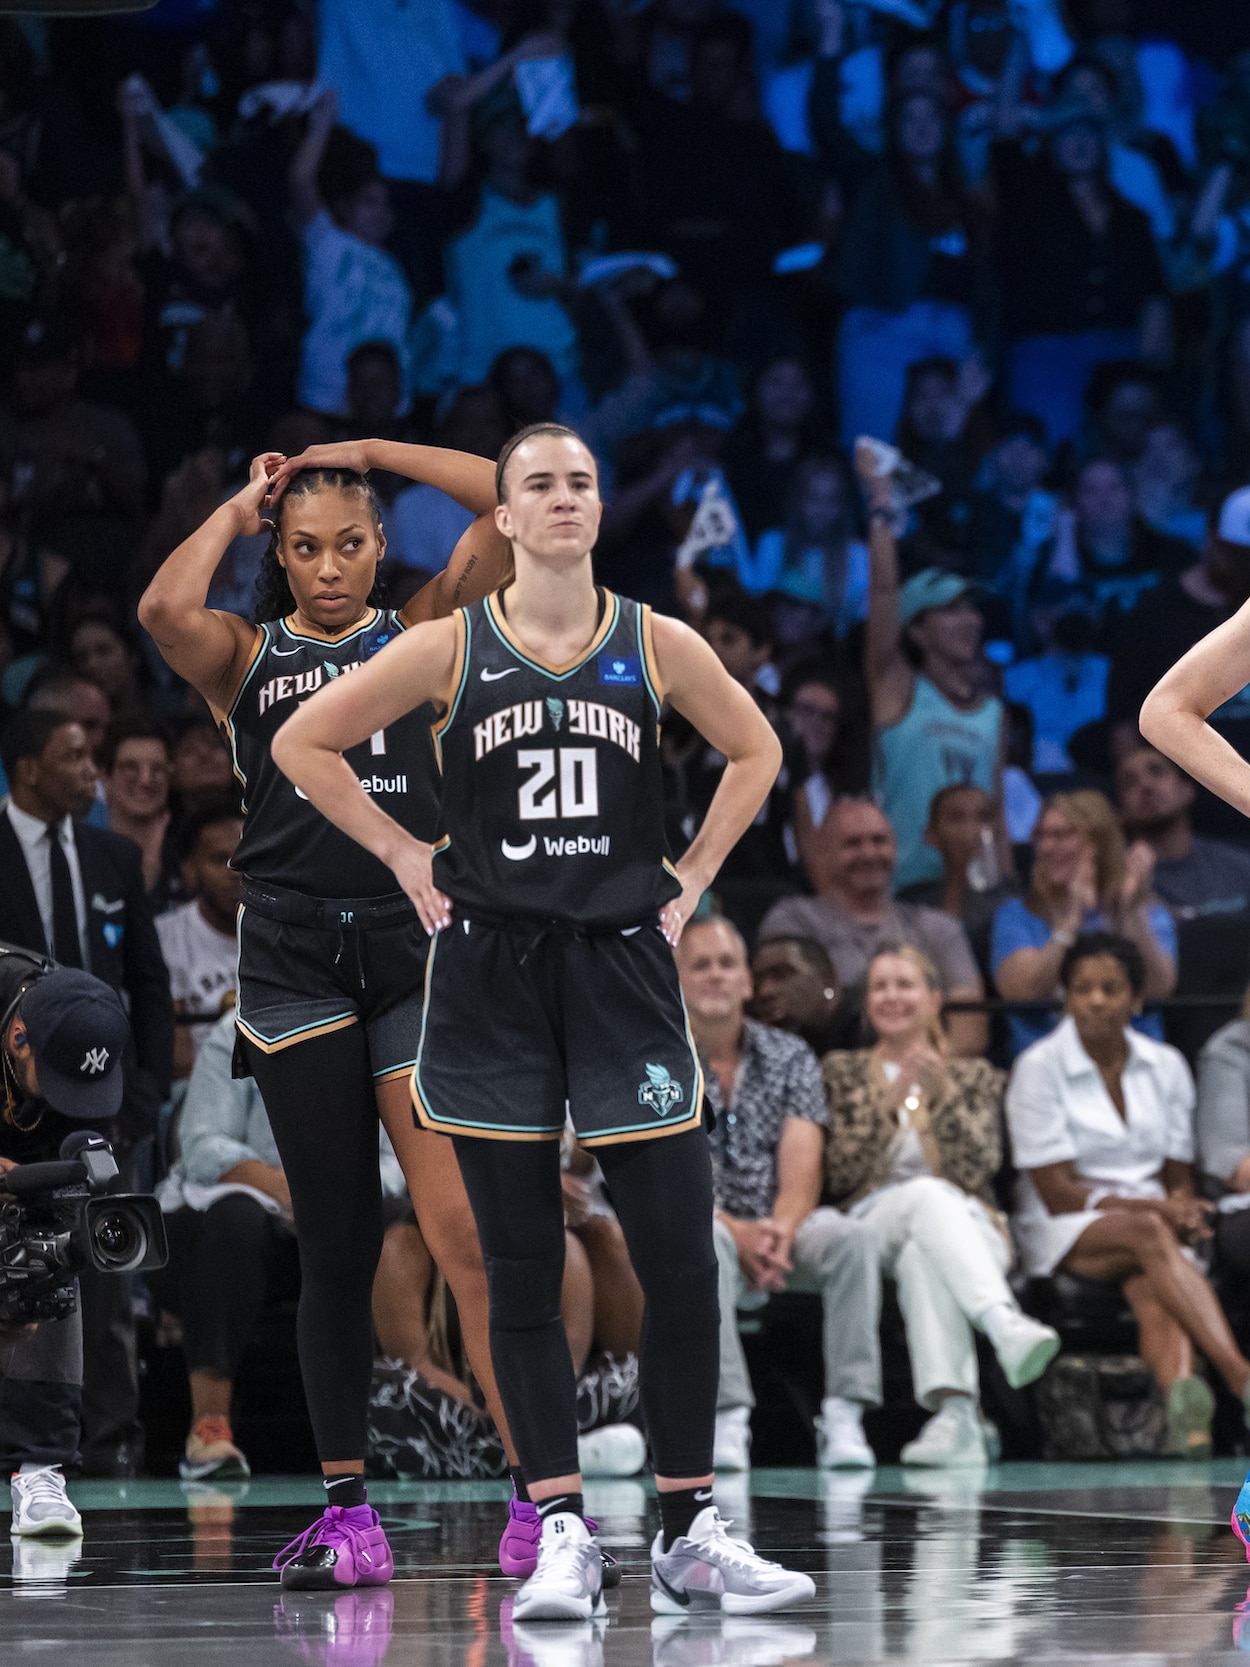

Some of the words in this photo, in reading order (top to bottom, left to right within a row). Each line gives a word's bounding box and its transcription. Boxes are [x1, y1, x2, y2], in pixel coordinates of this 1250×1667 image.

[257, 665, 323, 718] NEW
[603, 674, 637, 682] BARCLAYS
[473, 700, 544, 762] NEW
[566, 699, 641, 764] YORK
[357, 774, 408, 794] ebull
[517, 747, 599, 821] 20
[543, 835, 611, 857] Webull
[80, 1047, 109, 1075] NY
